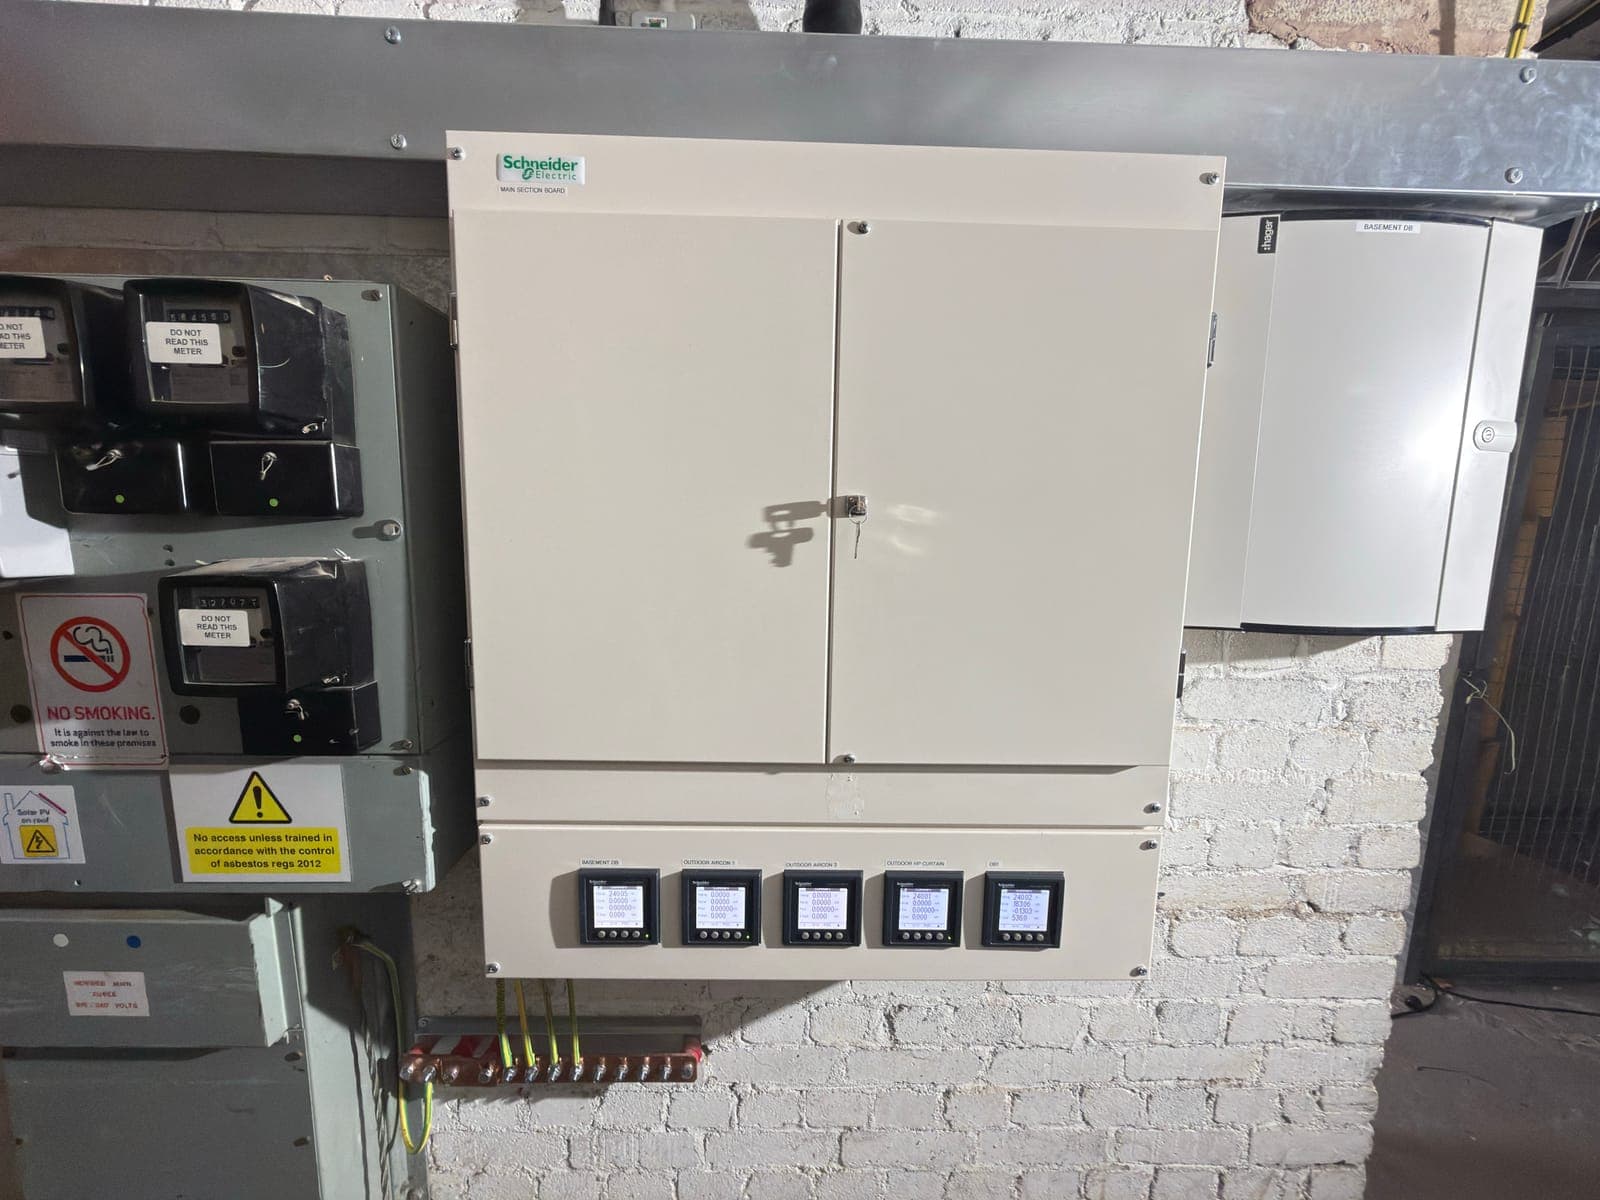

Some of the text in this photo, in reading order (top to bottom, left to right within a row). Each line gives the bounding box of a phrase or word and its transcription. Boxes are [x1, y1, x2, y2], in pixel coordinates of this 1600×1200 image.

[503, 155, 578, 171] Schneider
[535, 170, 577, 181] Electric
[517, 186, 542, 194] SECTION
[1363, 223, 1402, 231] BASEMENT
[12, 332, 32, 341] THIS
[169, 328, 202, 337] DO NOT
[165, 338, 209, 347] READ THIS
[173, 347, 203, 356] METER
[214, 615, 231, 623] NOT
[220, 623, 238, 631] THIS
[204, 631, 232, 639] METER
[46, 705, 71, 721] NO
[54, 728, 150, 739] It is against the law to
[50, 739, 157, 749] smoke in these premises
[193, 833, 333, 843] No access unless trained in
[194, 846, 335, 855] accordance with the control
[210, 859, 322, 870] of asbestos regs 2012
